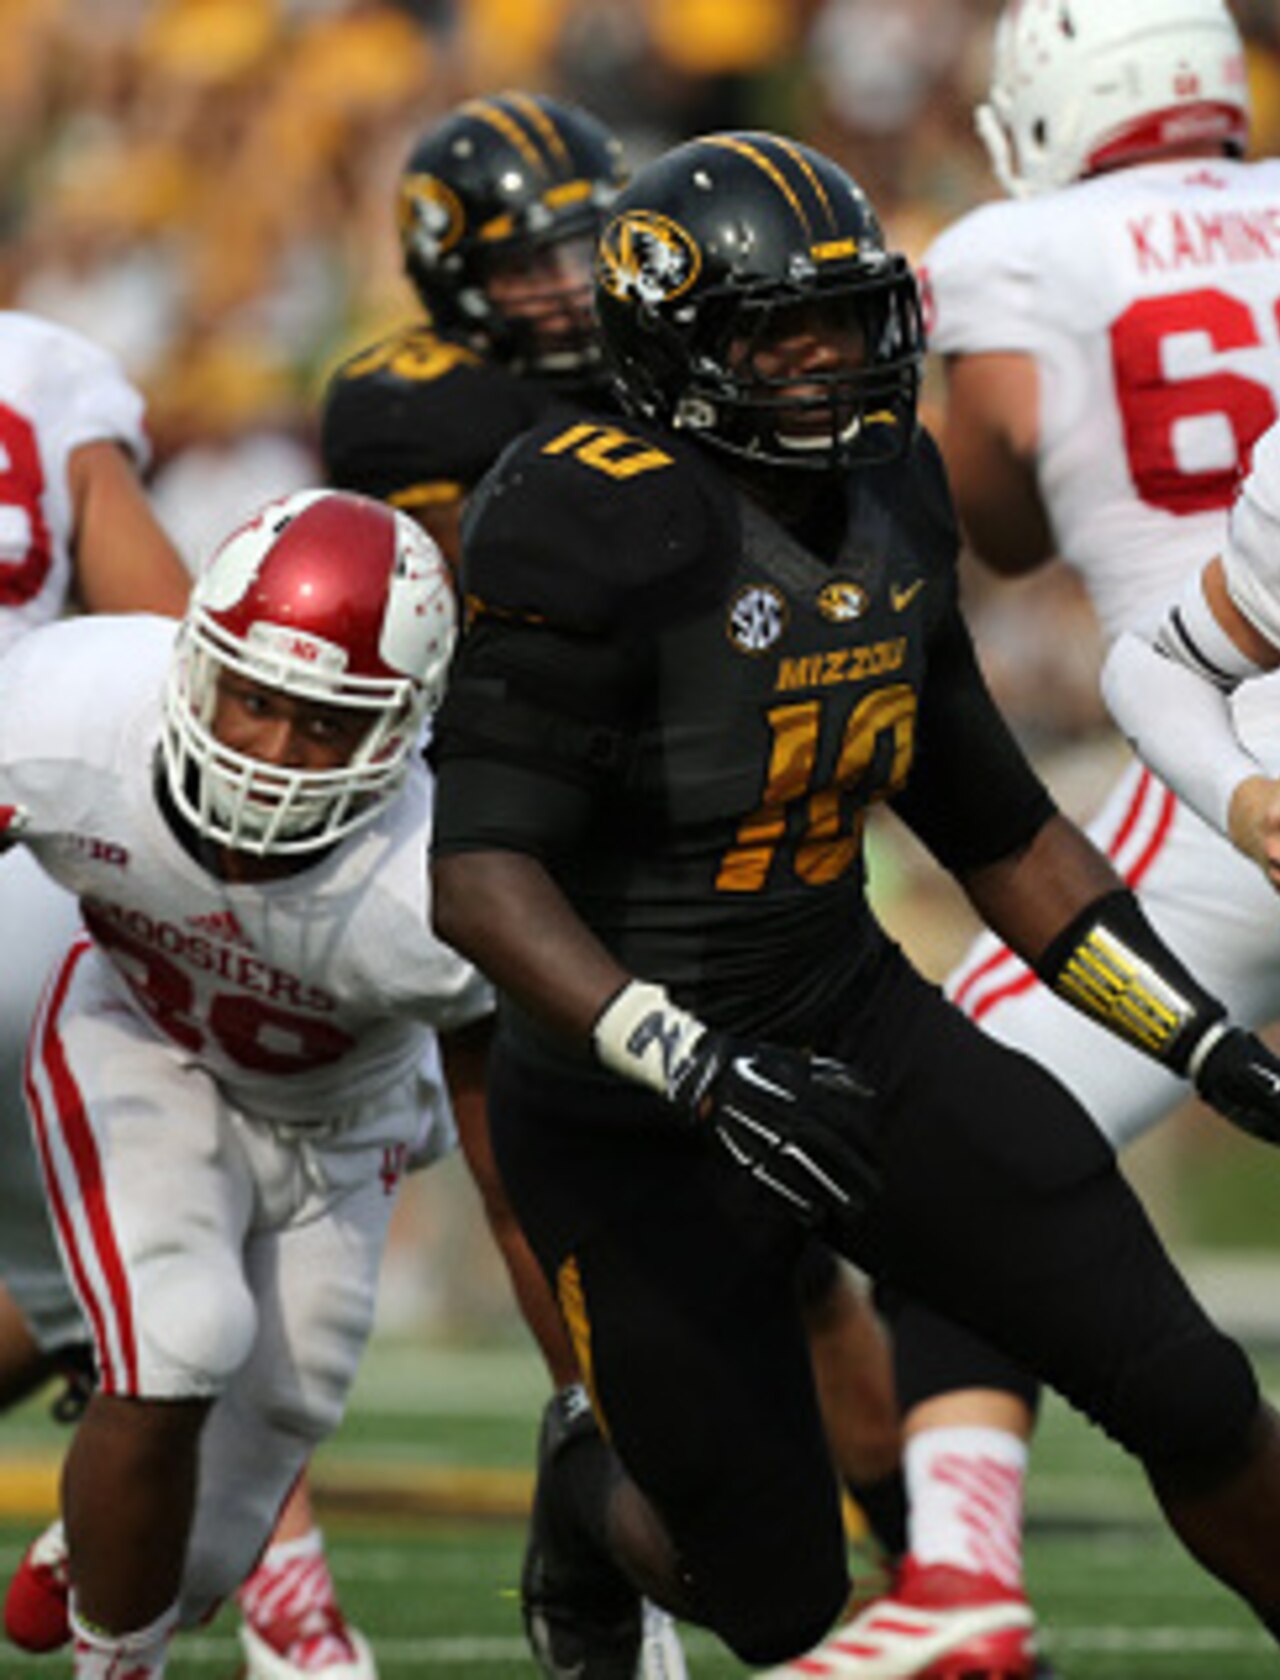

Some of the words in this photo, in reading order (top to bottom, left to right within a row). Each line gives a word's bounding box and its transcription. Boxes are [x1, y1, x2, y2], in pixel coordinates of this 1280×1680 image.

[540, 424, 676, 480] 10
[774, 637, 908, 691] MIZZOU
[715, 683, 918, 892] 10
